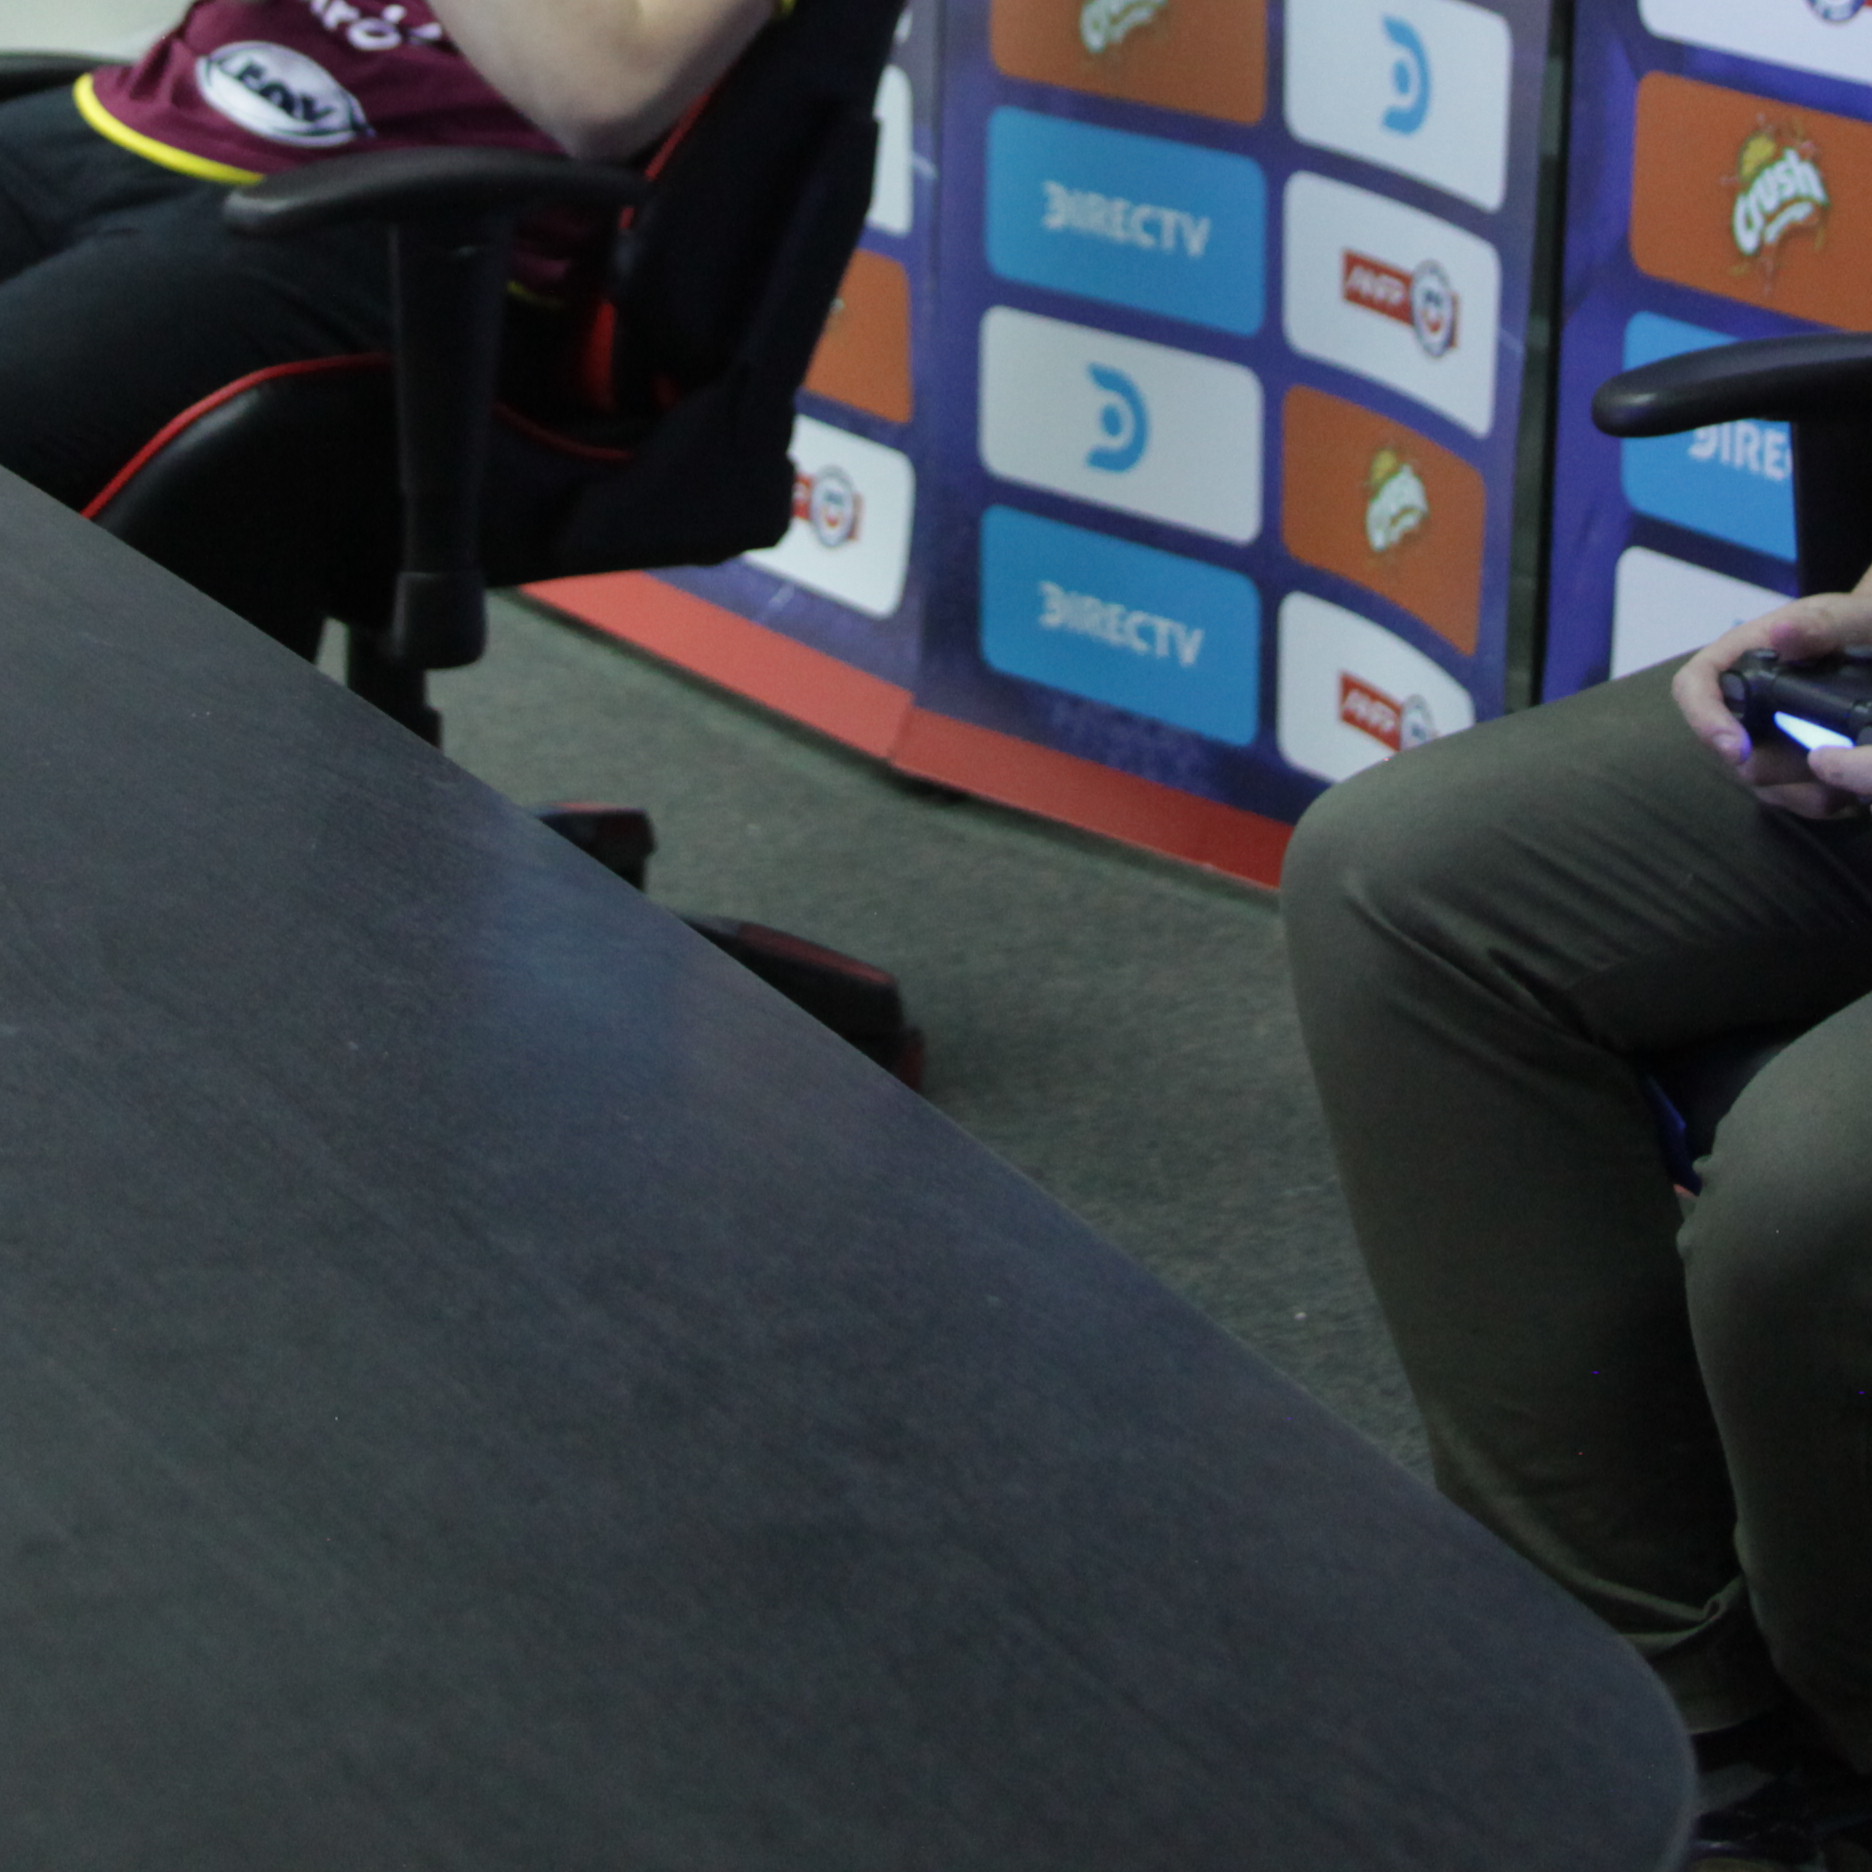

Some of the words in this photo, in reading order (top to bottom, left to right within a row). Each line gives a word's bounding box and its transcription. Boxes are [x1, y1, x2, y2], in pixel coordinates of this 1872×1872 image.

[1042, 180, 1211, 259] DIRECTV
[1688, 419, 1793, 481] DIRE
[1038, 581, 1204, 668] DIRECTV
